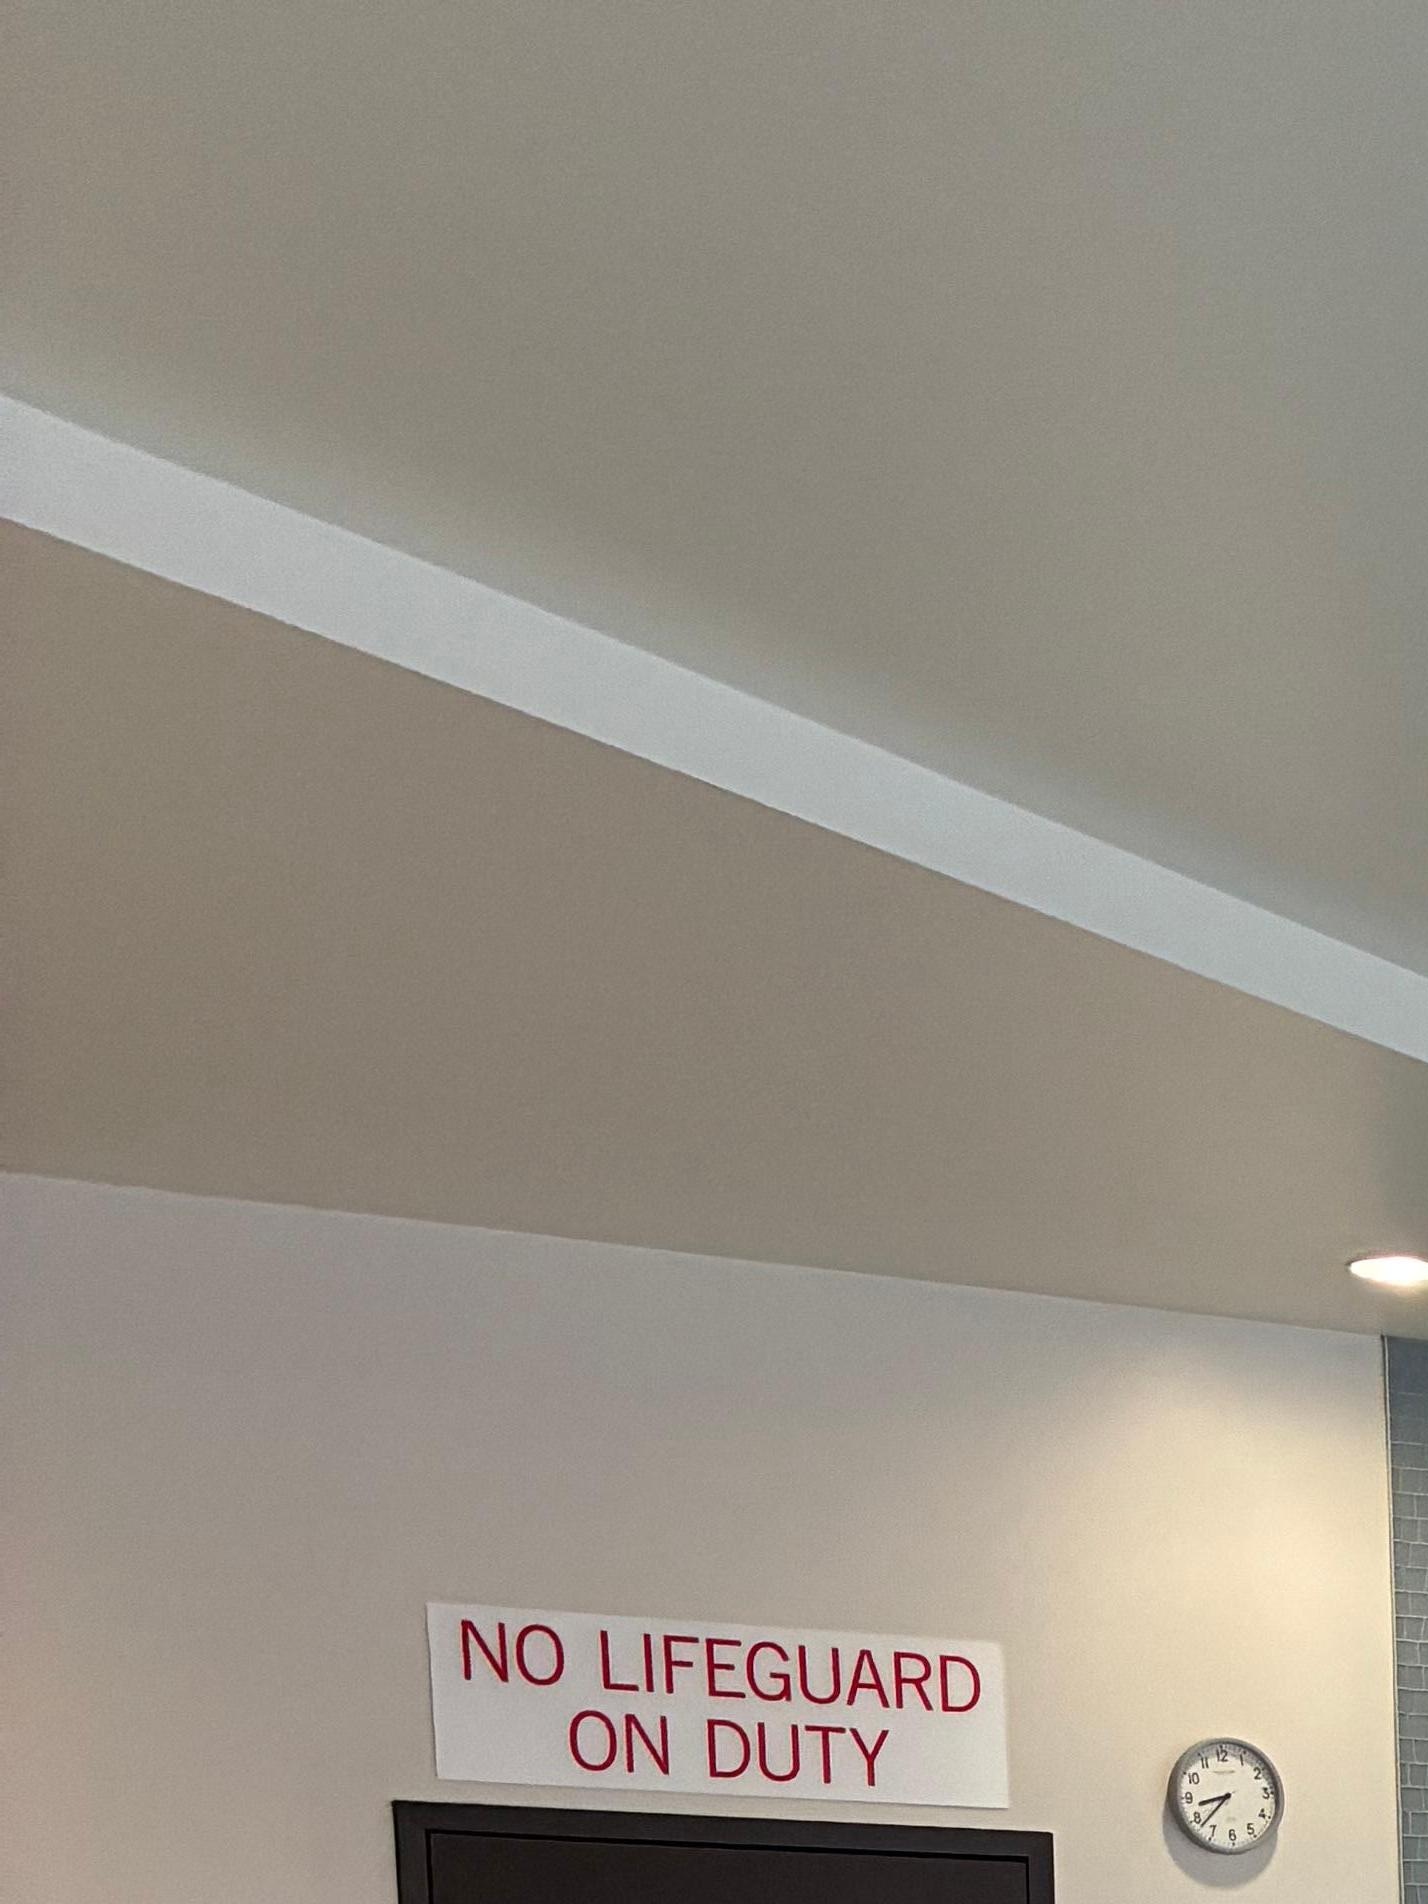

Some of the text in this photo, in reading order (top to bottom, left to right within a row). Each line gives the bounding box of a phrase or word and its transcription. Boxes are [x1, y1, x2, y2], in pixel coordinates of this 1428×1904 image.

[460, 1619, 982, 1713] NO LIFEGUARD
[568, 1709, 890, 1787] ON DUTY
[1216, 1749, 1228, 1762] 12
[1240, 1754, 1244, 1766] 1
[1201, 1757, 1209, 1769] 11
[1188, 1772, 1200, 1784] 10
[1253, 1767, 1262, 1780] 2
[1185, 1791, 1193, 1804] 9
[1262, 1787, 1270, 1799] 3
[1193, 1811, 1202, 1824] 8
[1258, 1808, 1266, 1819] 4
[1209, 1825, 1217, 1838] 7
[1228, 1829, 1237, 1841] 6
[1247, 1823, 1255, 1835] 5
